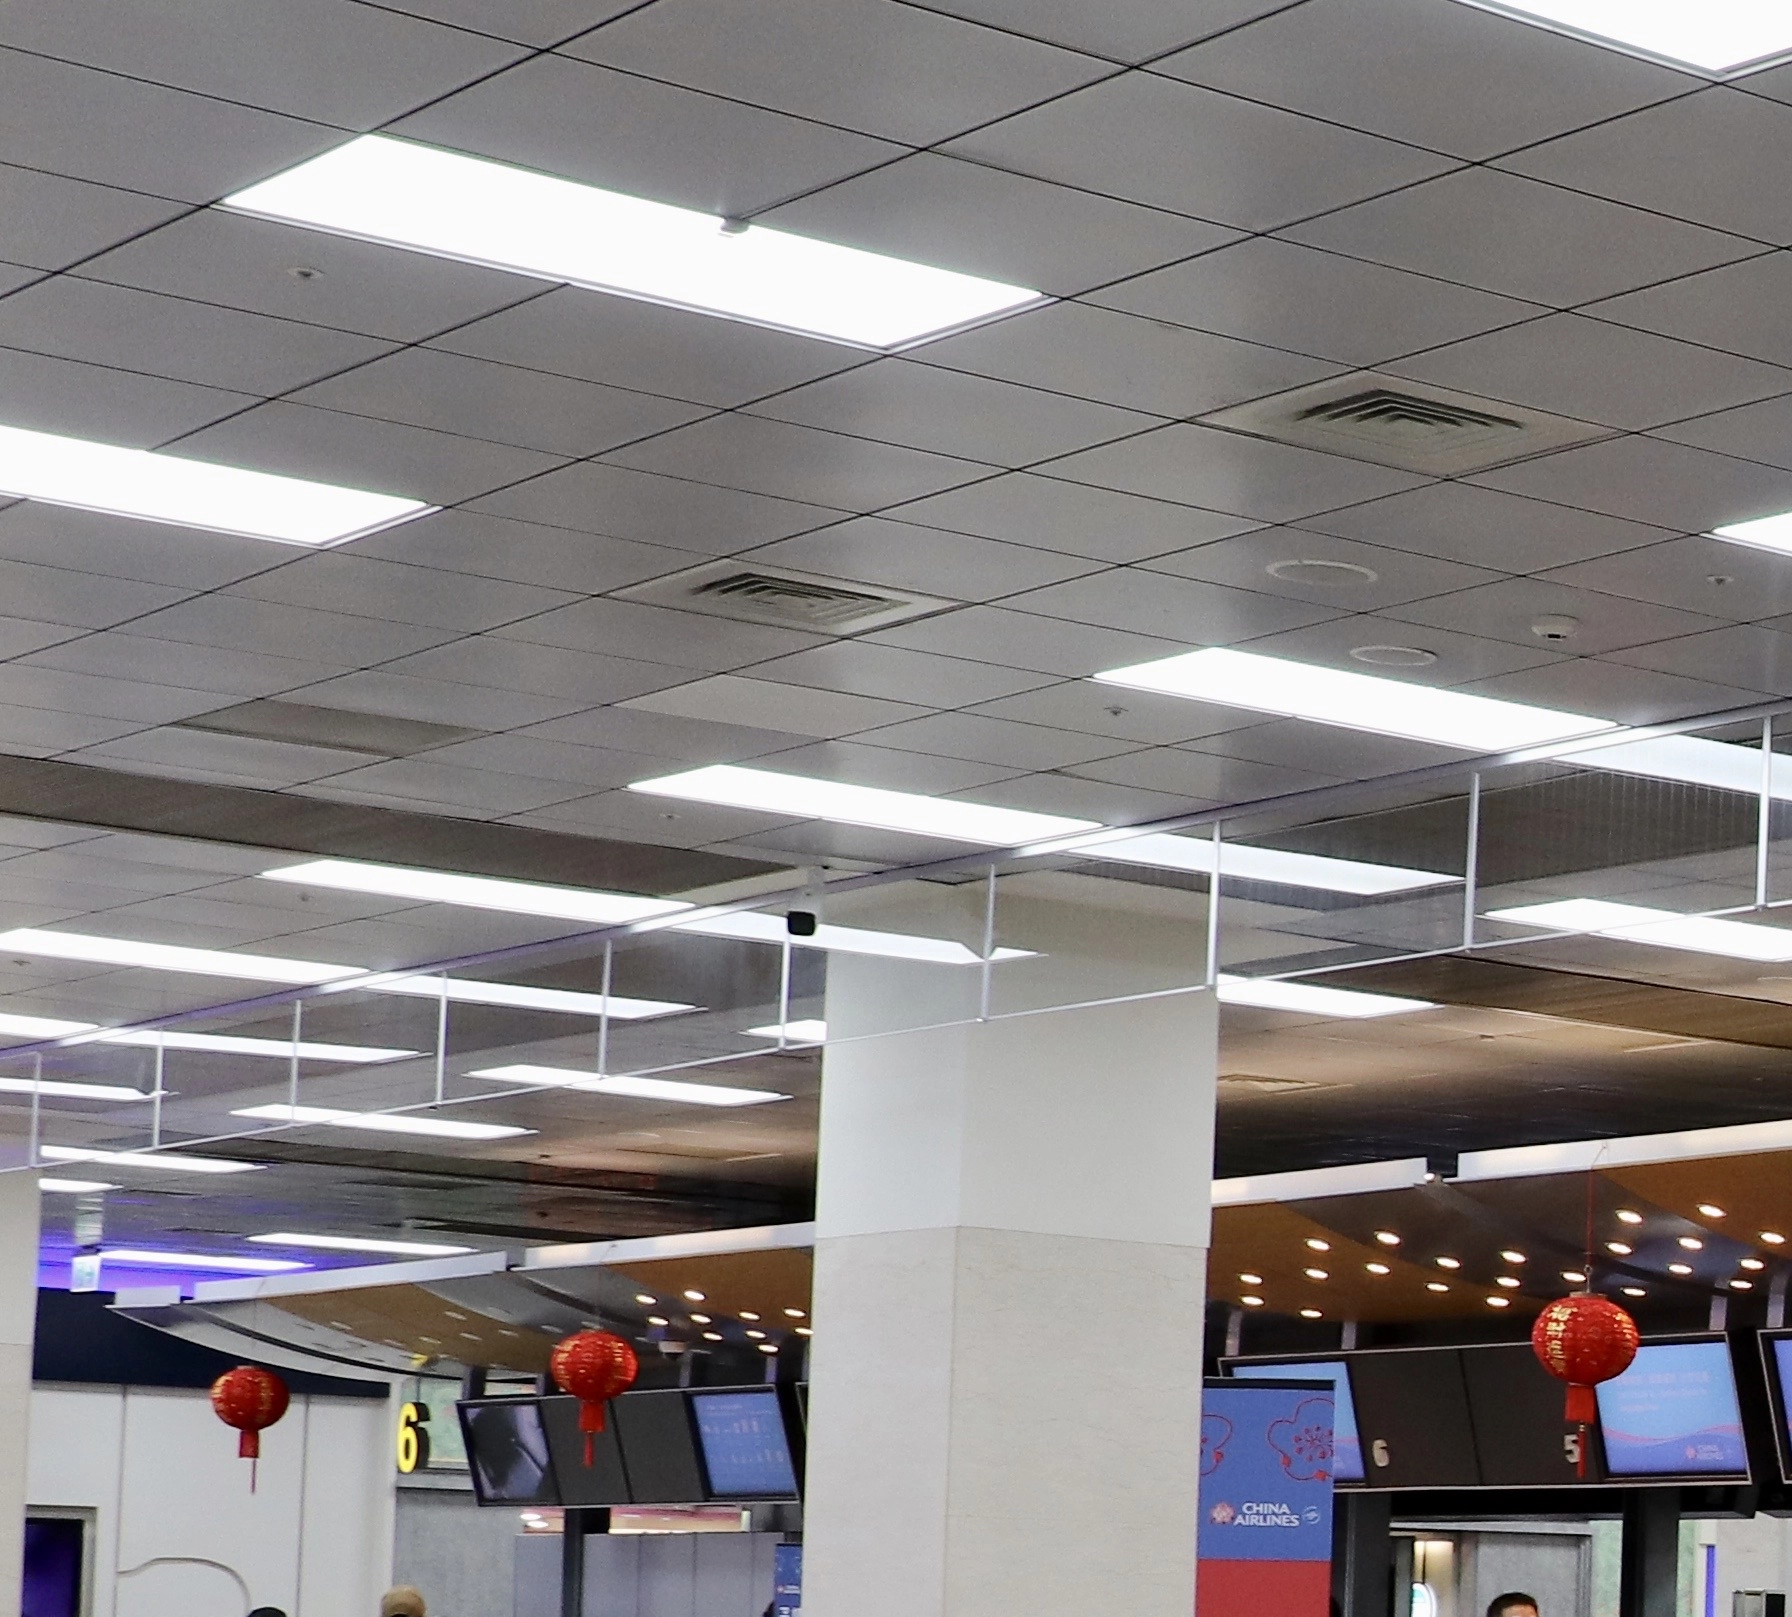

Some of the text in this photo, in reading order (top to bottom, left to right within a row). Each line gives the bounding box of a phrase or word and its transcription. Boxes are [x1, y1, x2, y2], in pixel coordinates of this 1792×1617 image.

[396, 1402, 419, 1474] 6
[1372, 1438, 1390, 1468] 6
[1564, 1434, 1581, 1464] 5
[1233, 1514, 1300, 1527] AIRLINES
[1241, 1502, 1291, 1514] CHINA
